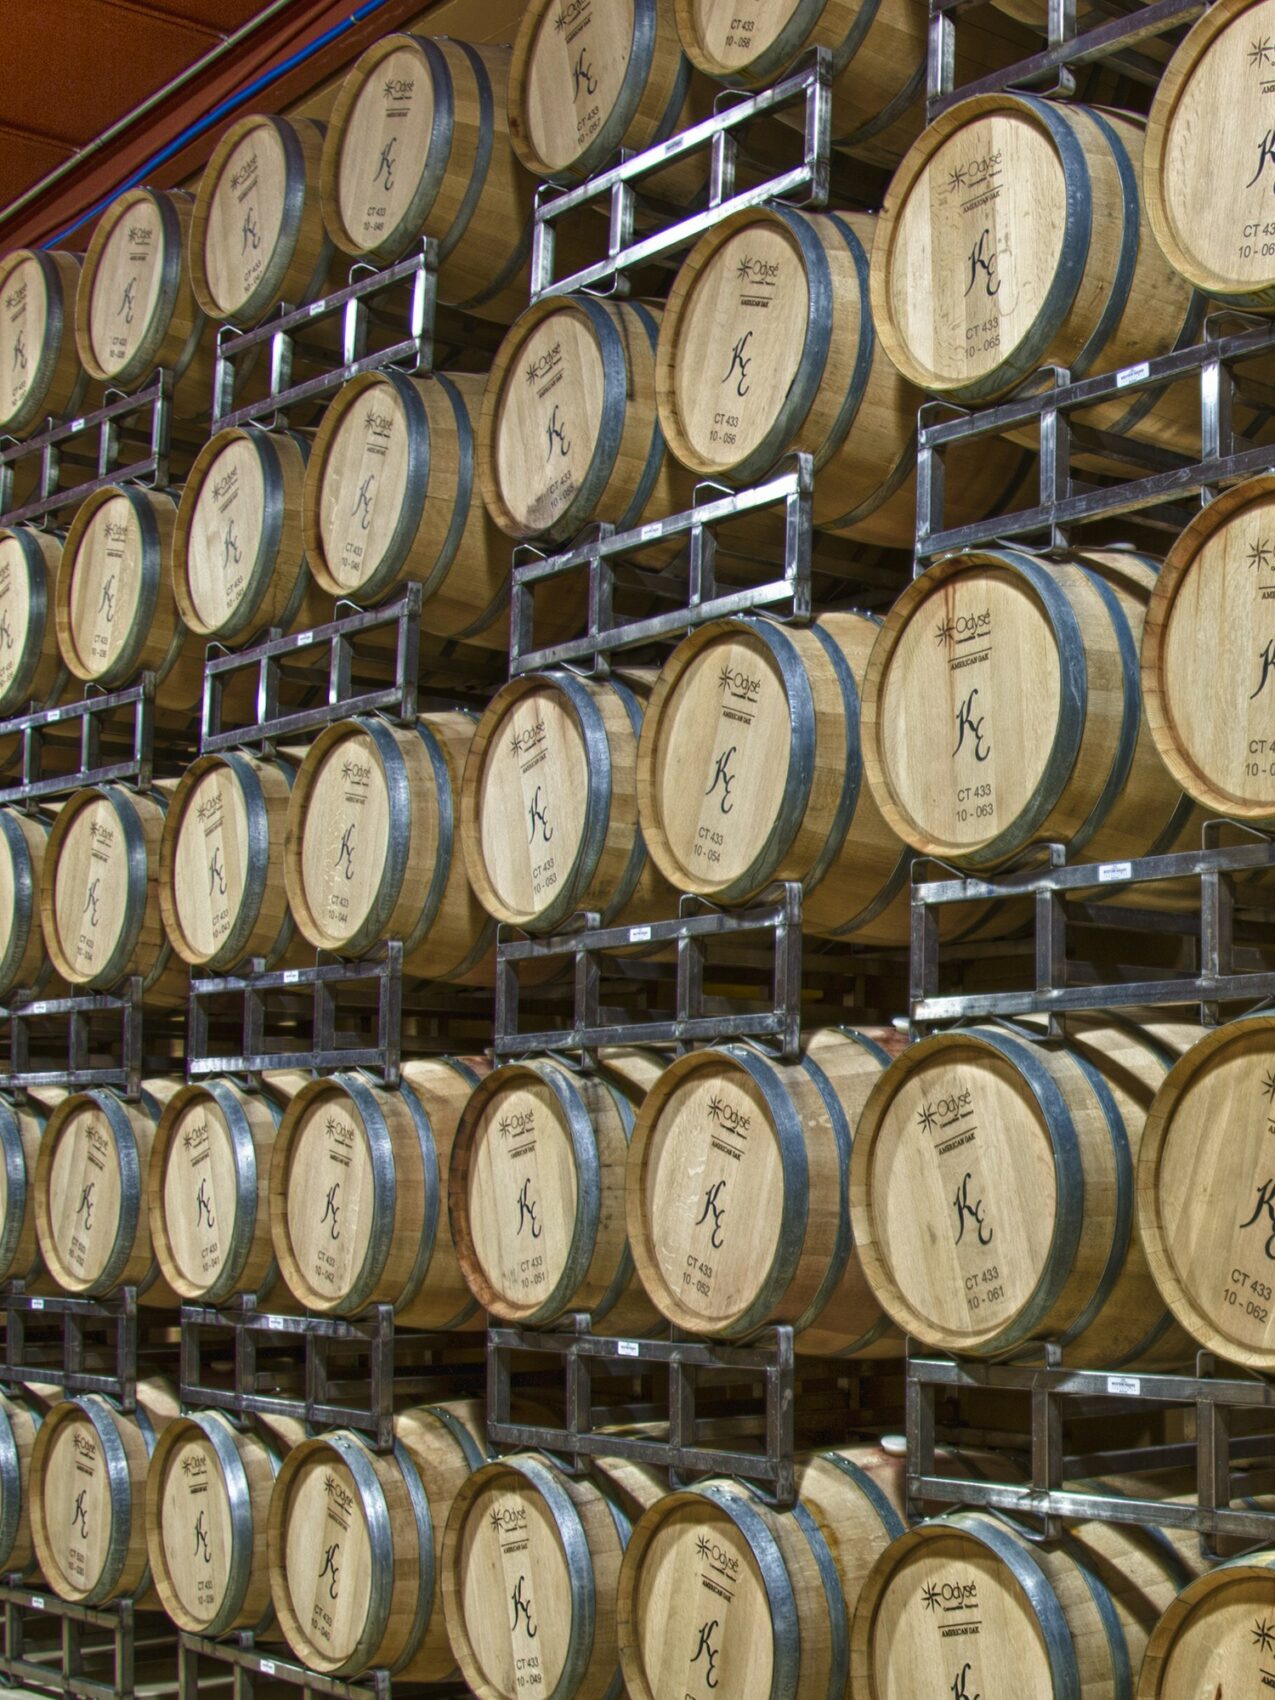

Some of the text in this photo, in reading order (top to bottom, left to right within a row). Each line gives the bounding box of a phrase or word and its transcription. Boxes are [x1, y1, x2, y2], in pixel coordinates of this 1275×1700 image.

[1243, 223, 1261, 238] CT
[964, 228, 1001, 296] KE
[1238, 245, 1252, 259] 10
[965, 317, 999, 340] CT 433
[714, 413, 739, 428] CT 433
[955, 608, 990, 634] Odysé
[952, 688, 990, 762] KE
[1249, 740, 1267, 754] CT
[1245, 763, 1260, 776] 10
[957, 784, 992, 802] CT 433
[956, 809, 968, 822] 10
[698, 827, 724, 846] CT 433
[532, 858, 554, 879] CT 433
[937, 1088, 972, 1118] Odysé
[953, 1172, 993, 1246] KE
[520, 1256, 543, 1273] CT 433
[687, 1255, 712, 1279] CT 433
[965, 1266, 999, 1290] CT 433
[1231, 1268, 1273, 1300] CT 433
[1223, 1288, 1237, 1305] 10
[1245, 1301, 1268, 1324] 062
[942, 1580, 977, 1604] Odysé
[516, 1656, 538, 1670] CT 433
